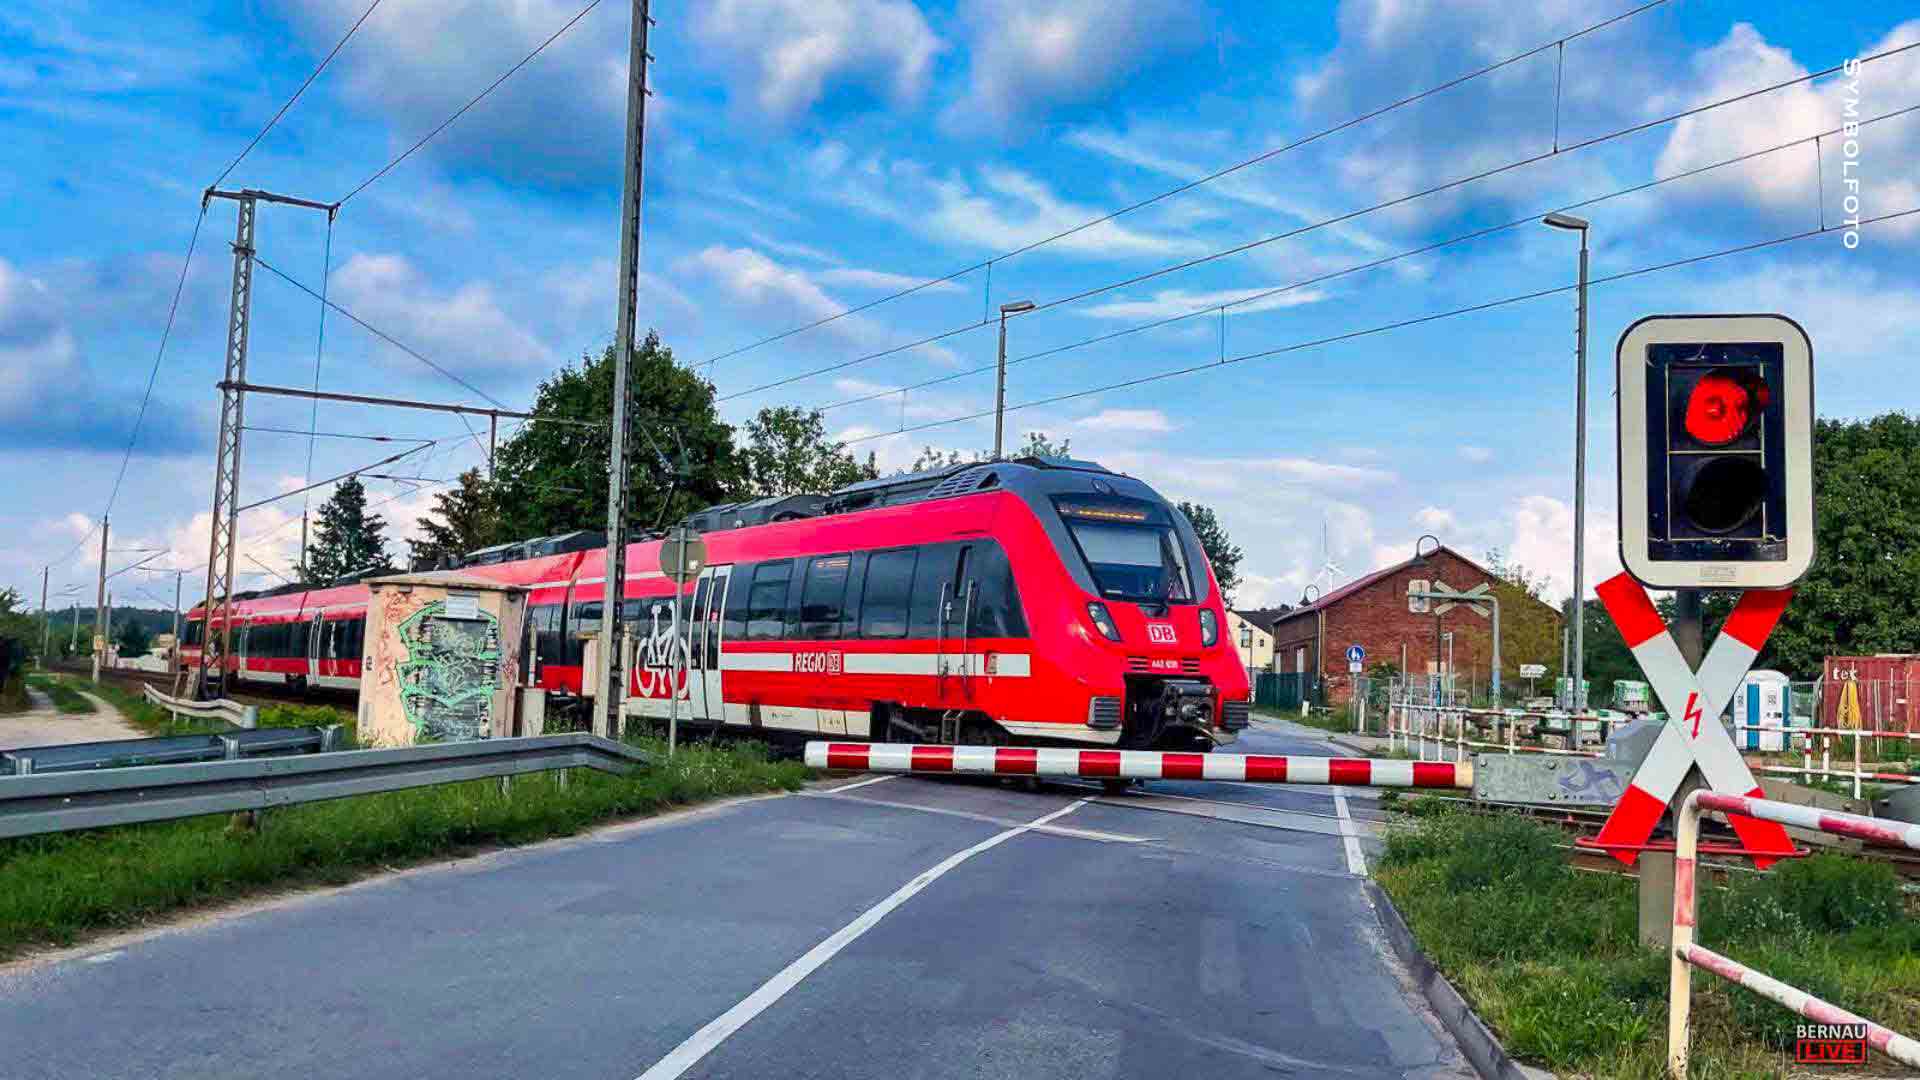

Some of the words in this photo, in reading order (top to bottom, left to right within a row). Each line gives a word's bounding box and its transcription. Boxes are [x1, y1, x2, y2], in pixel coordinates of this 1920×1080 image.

[1149, 625, 1175, 642] DB
[795, 652, 825, 672] REGIO
[828, 653, 841, 672] DB
